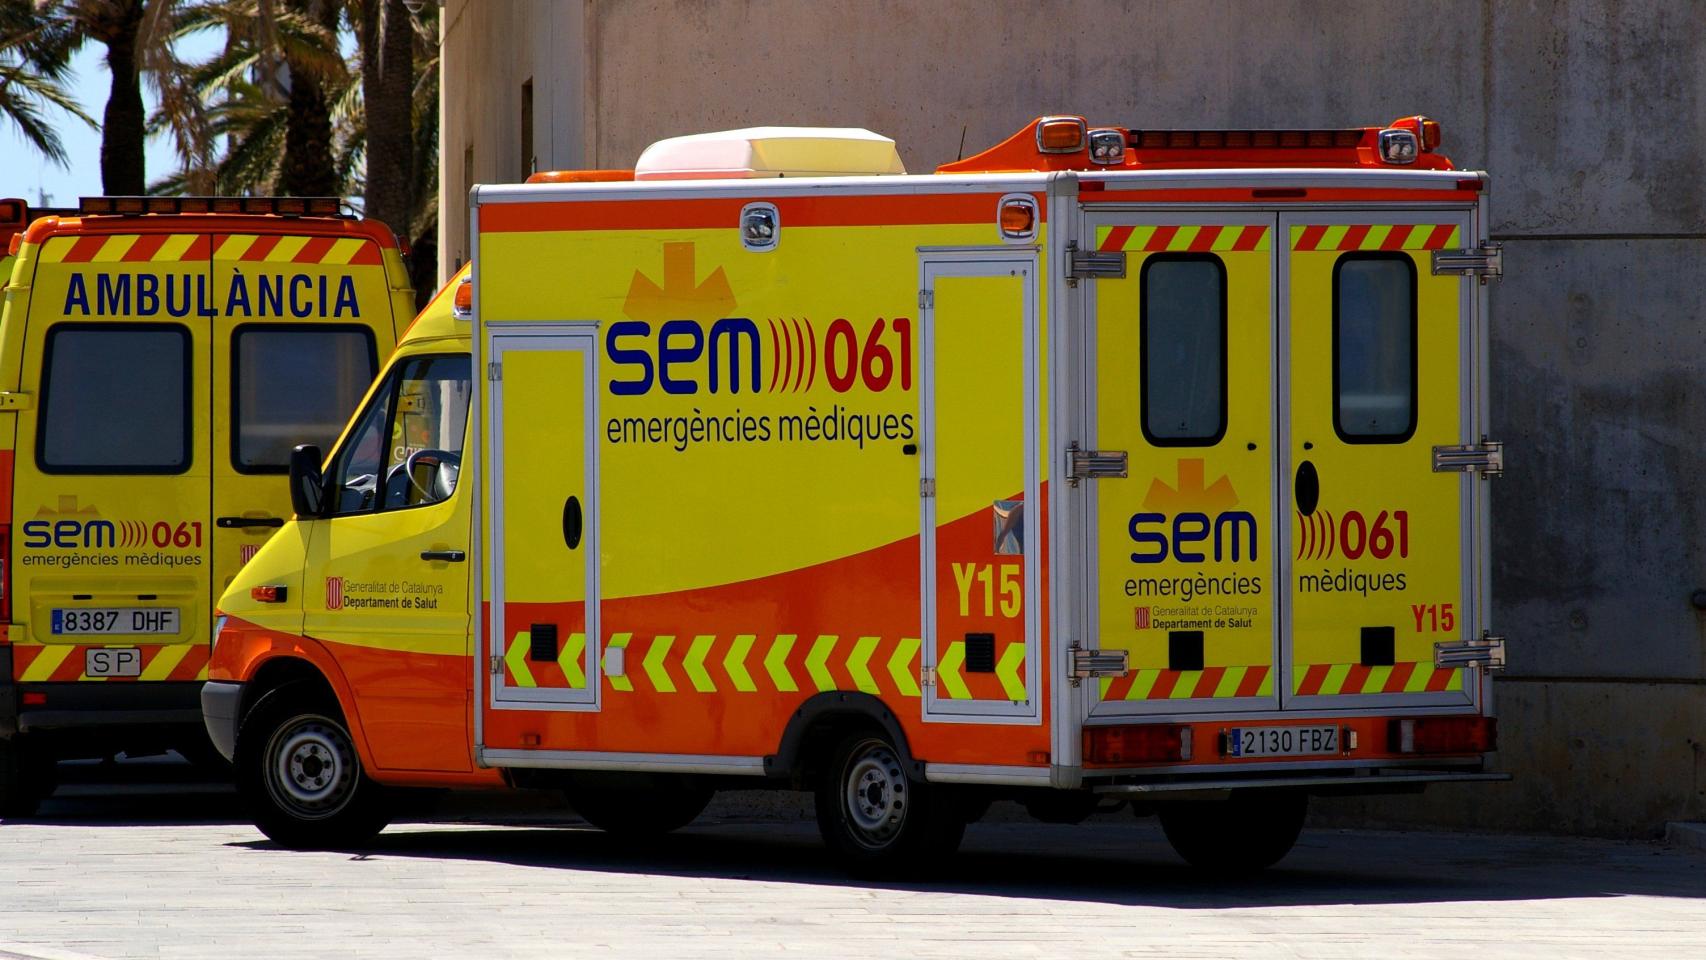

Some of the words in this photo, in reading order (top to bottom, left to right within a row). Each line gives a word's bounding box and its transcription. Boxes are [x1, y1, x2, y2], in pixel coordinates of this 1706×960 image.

[63, 267, 360, 318] AMBULÀNCIA
[605, 317, 761, 396] sem
[824, 317, 912, 393] 061
[606, 408, 771, 452] emergències
[778, 404, 914, 450] mèdiques
[23, 520, 115, 548] sem
[151, 521, 202, 548] 061
[1128, 511, 1258, 564] sem
[1339, 510, 1409, 560] 061
[22, 552, 119, 568] emergències
[125, 552, 202, 568] mèdiques
[343, 579, 387, 593] Generalitat
[389, 580, 400, 594] de
[401, 580, 443, 596] Catalunya
[951, 562, 1022, 619] Y15
[1124, 571, 1262, 602] emergències
[1299, 568, 1407, 598] mèdiques
[343, 595, 399, 610] Departament
[401, 596, 412, 609] de
[414, 596, 438, 609] Salut
[1152, 605, 1199, 617] Generalitat
[1201, 605, 1213, 616] de
[1214, 604, 1258, 618] Catalunya
[65, 611, 119, 631] 8387
[132, 611, 173, 631] DHF
[1152, 618, 1212, 631] Departament
[1214, 618, 1226, 628] de
[1228, 617, 1252, 628] Salut
[1410, 603, 1455, 633] Y15
[1244, 730, 1293, 754] 2130
[1299, 729, 1335, 752] FBZ
